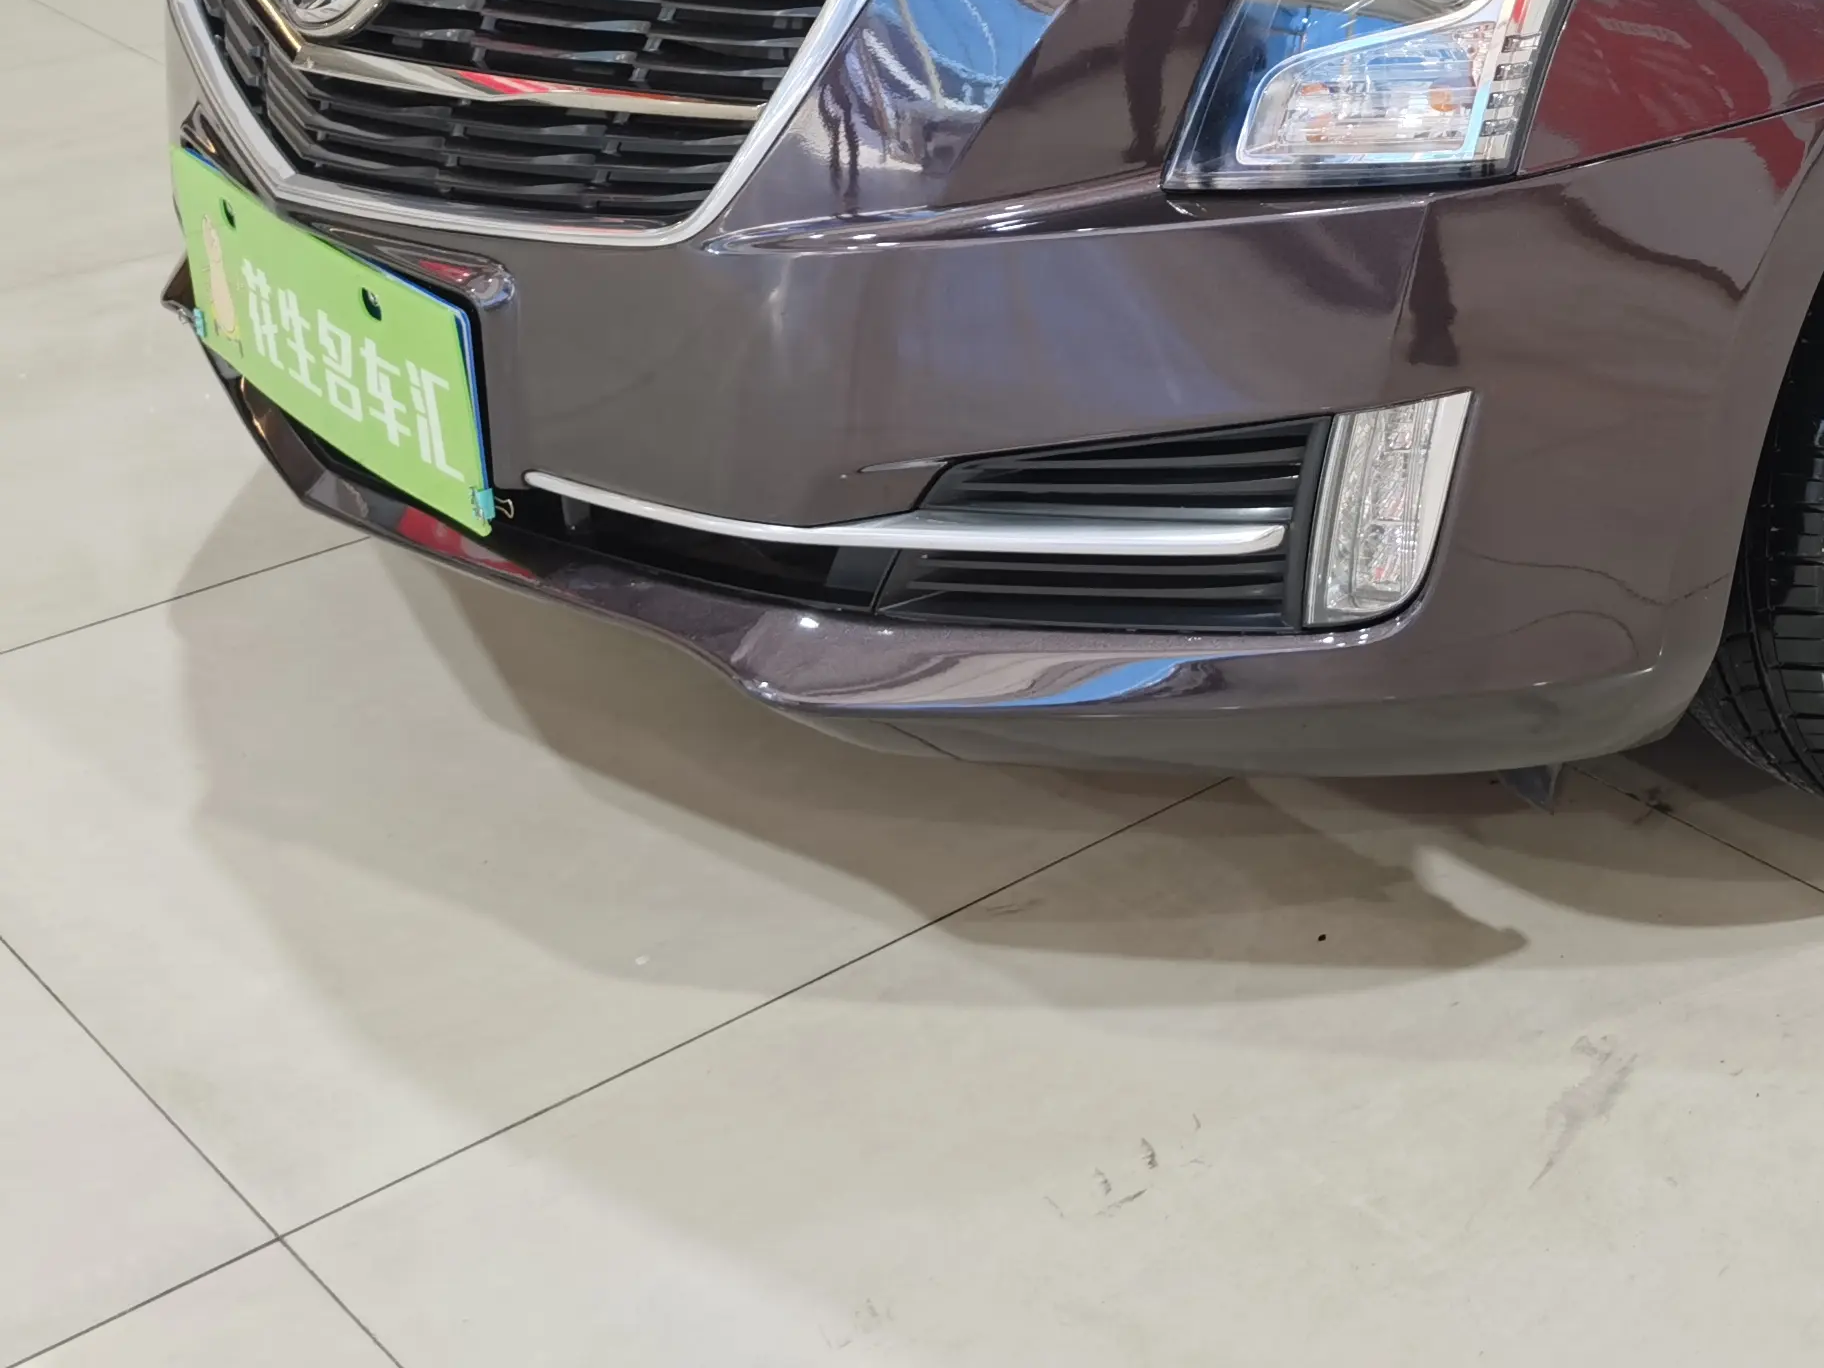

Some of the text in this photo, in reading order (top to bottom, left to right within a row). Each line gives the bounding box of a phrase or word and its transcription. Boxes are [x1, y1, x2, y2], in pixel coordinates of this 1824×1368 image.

[241, 258, 465, 482] 花生名车汇
